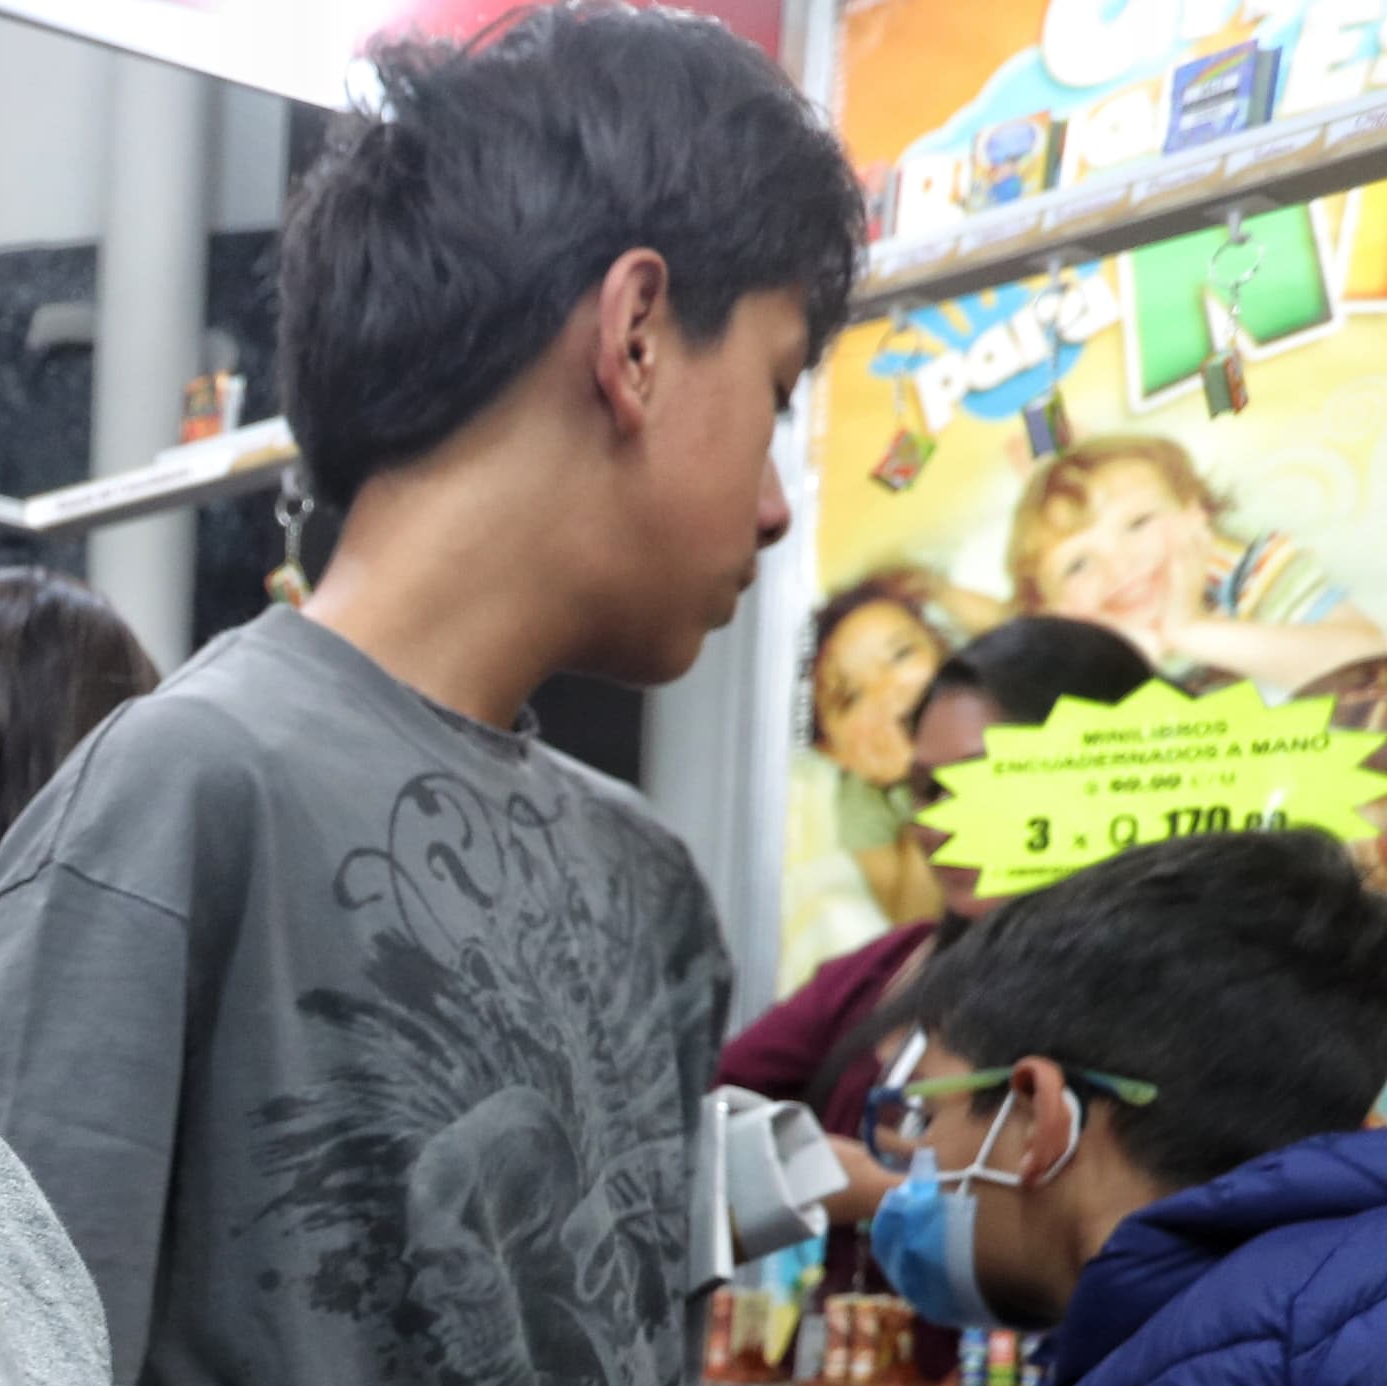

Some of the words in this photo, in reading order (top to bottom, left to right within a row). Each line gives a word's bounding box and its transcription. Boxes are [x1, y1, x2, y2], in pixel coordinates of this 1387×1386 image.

[993, 746, 1217, 777] ENCUADERNADOS
[1251, 735, 1330, 755] MANO
[1027, 816, 1051, 852] 3
